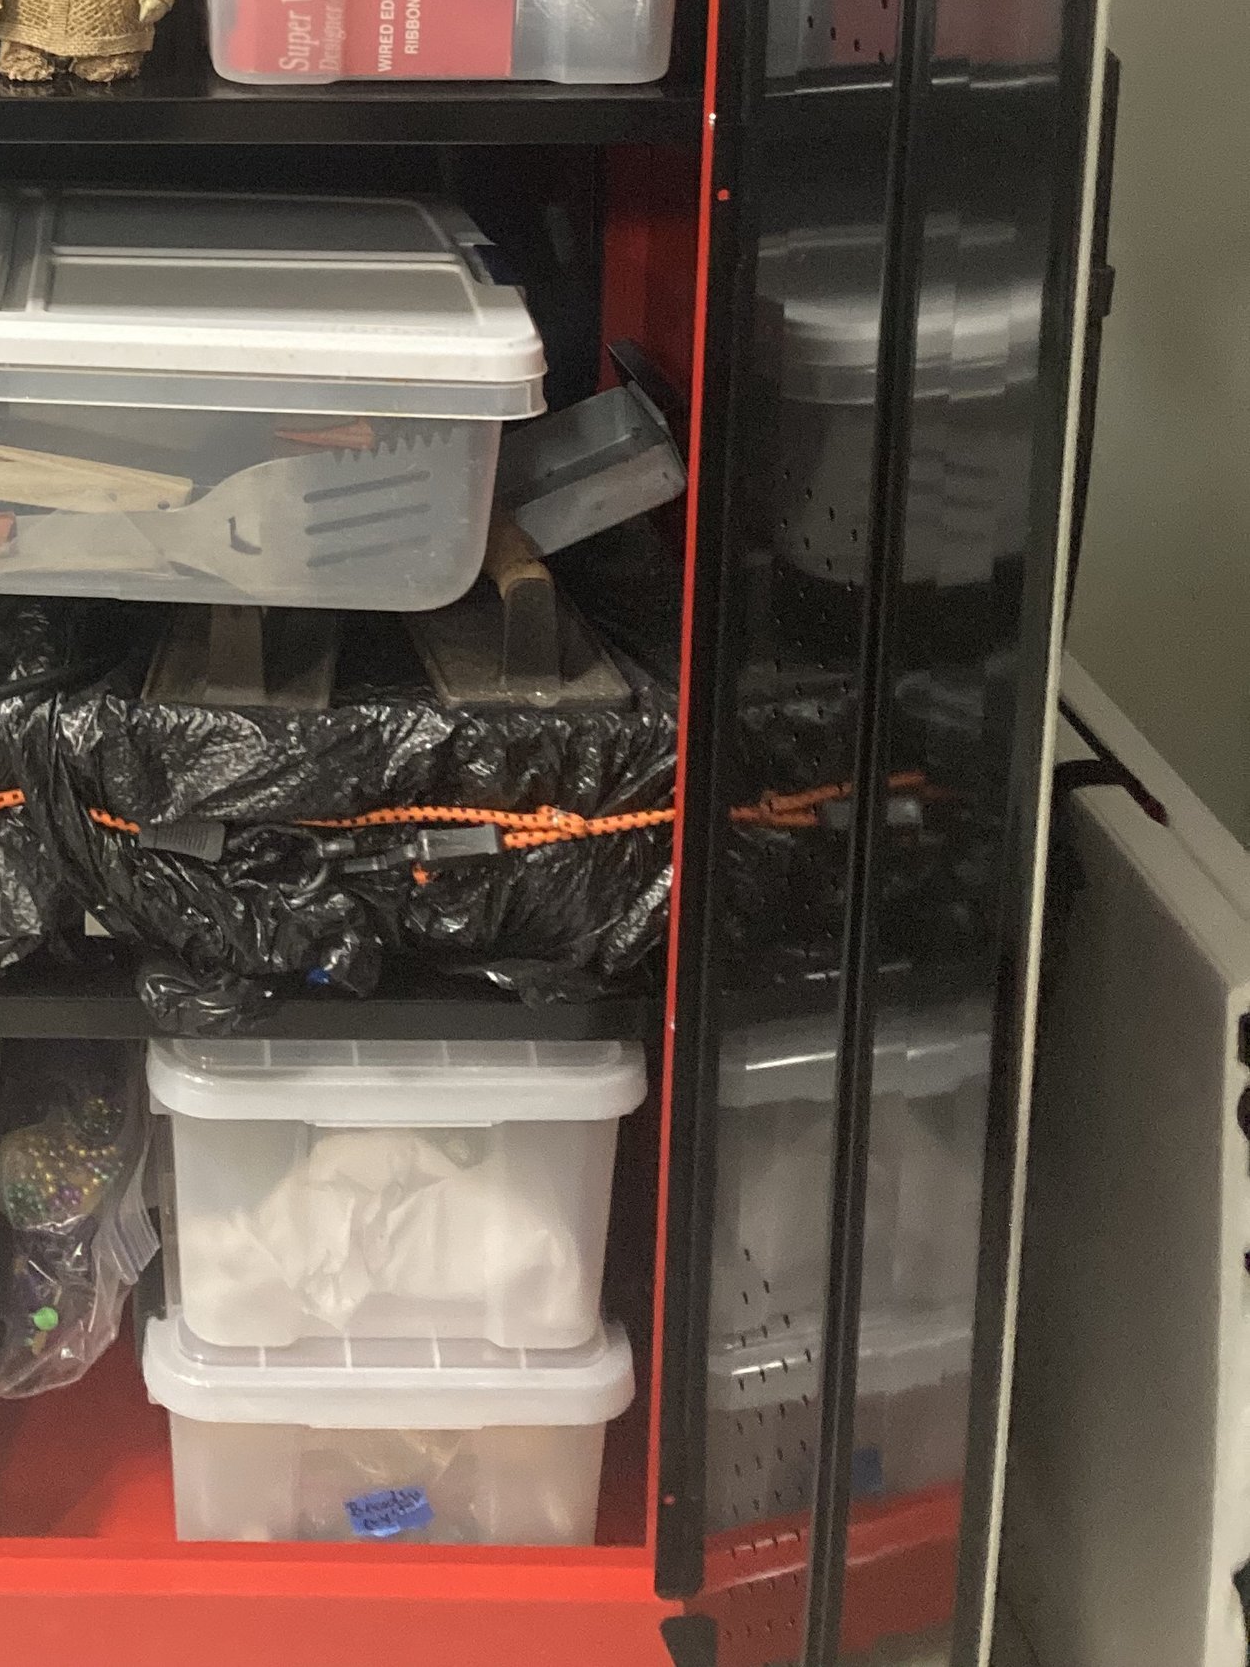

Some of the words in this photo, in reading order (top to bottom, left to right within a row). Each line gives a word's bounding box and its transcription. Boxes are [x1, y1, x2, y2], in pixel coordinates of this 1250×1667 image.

[279, 10, 320, 72] Super
[318, 4, 347, 72] Designer
[377, 23, 393, 72] WIRED
